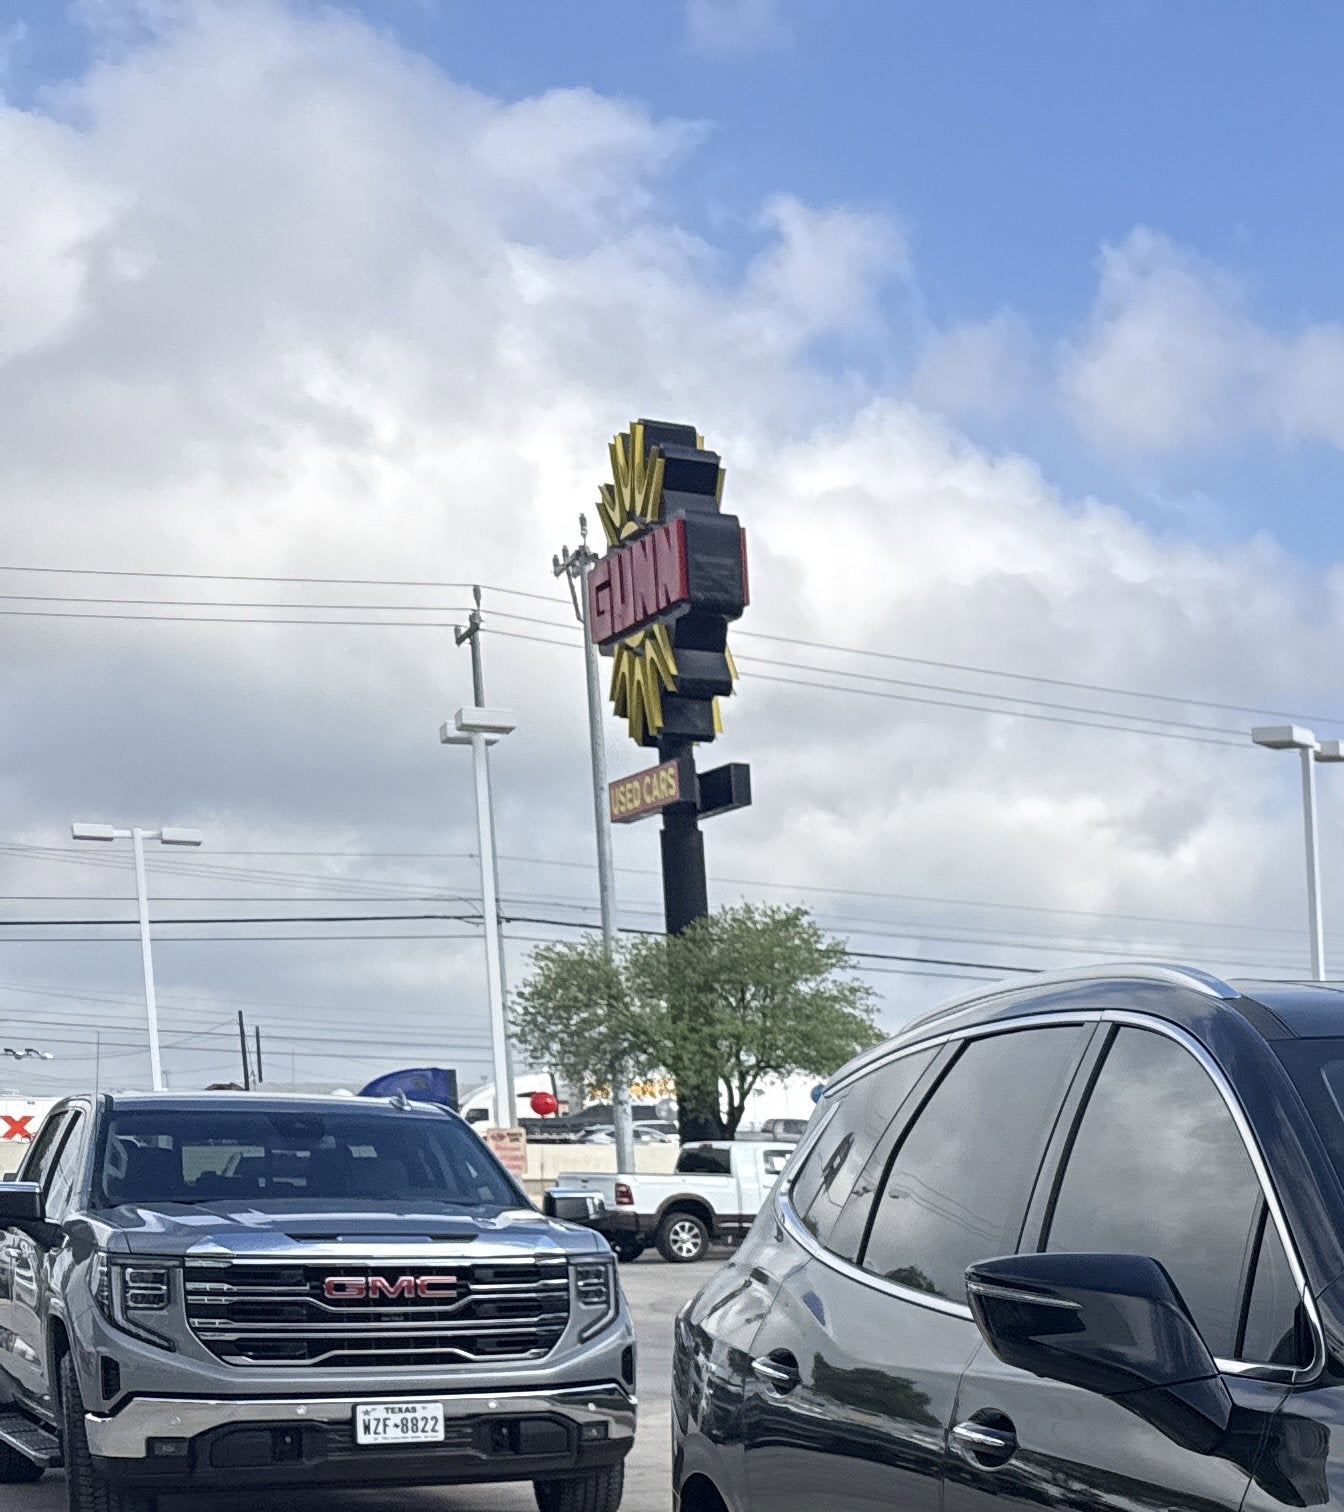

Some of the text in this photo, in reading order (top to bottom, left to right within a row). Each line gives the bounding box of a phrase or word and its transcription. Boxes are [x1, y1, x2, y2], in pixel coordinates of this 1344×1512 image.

[588, 519, 688, 644] GUNN
[611, 767, 677, 815] USED CARS
[323, 1275, 457, 1299] GMC
[384, 1406, 417, 1415] TEXAS
